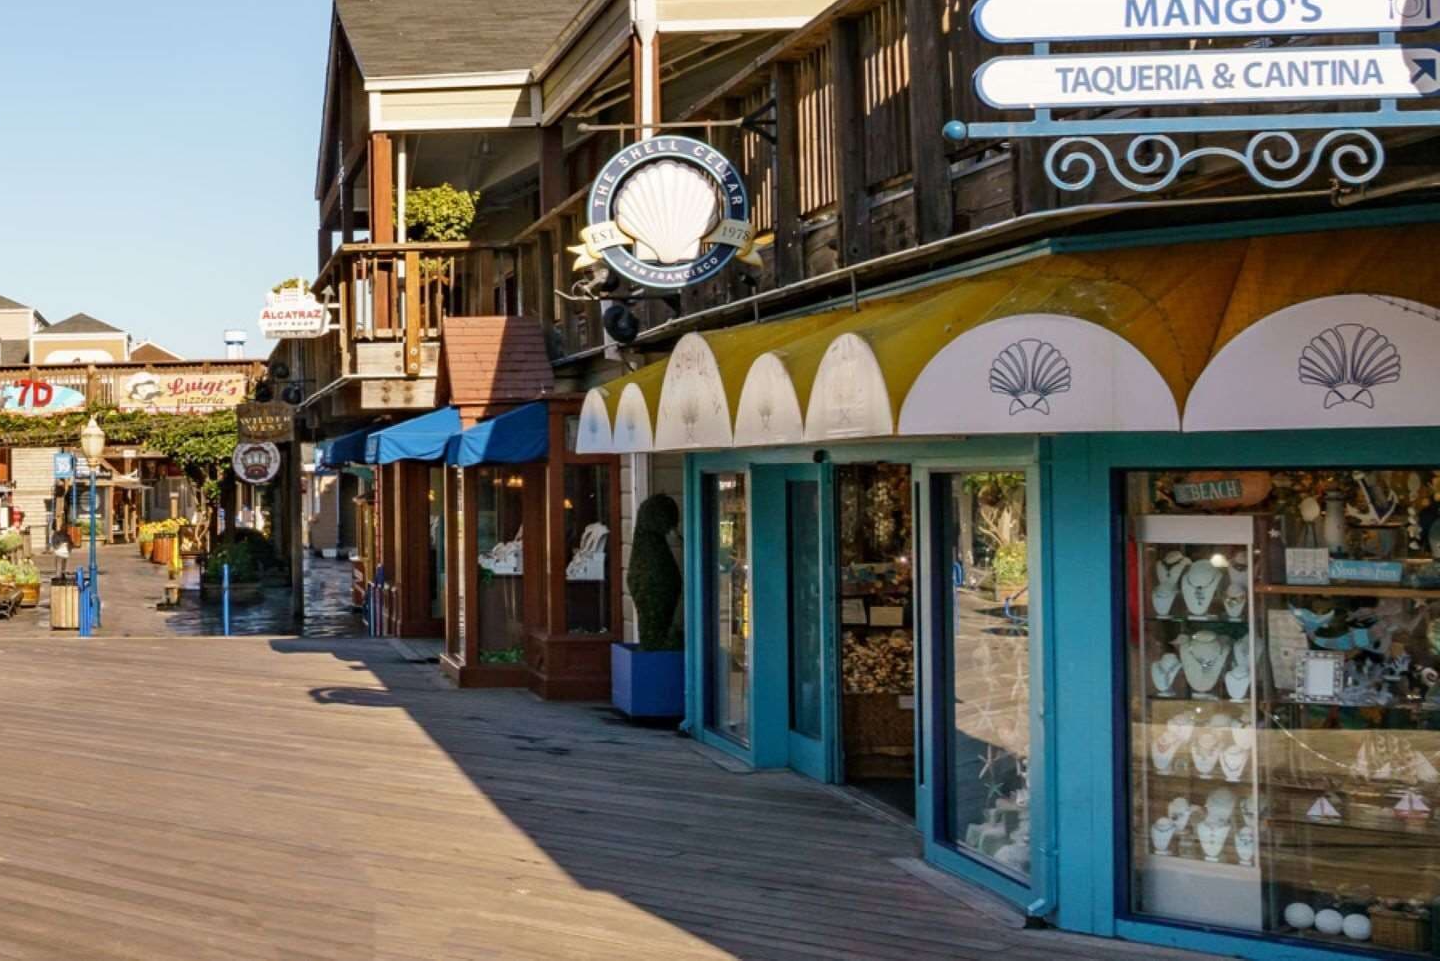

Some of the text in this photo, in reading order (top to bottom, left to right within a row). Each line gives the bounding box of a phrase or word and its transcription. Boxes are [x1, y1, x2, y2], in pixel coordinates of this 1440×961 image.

[1056, 57, 1384, 95] TAQUERIA & CANTINA
[594, 140, 743, 209] THE SHELL CELLAR
[623, 257, 718, 281] SAN FRANCISCO
[262, 309, 321, 320] ALCATRAZ
[166, 377, 239, 397] Luigi's
[1191, 480, 1241, 500] BEACH
